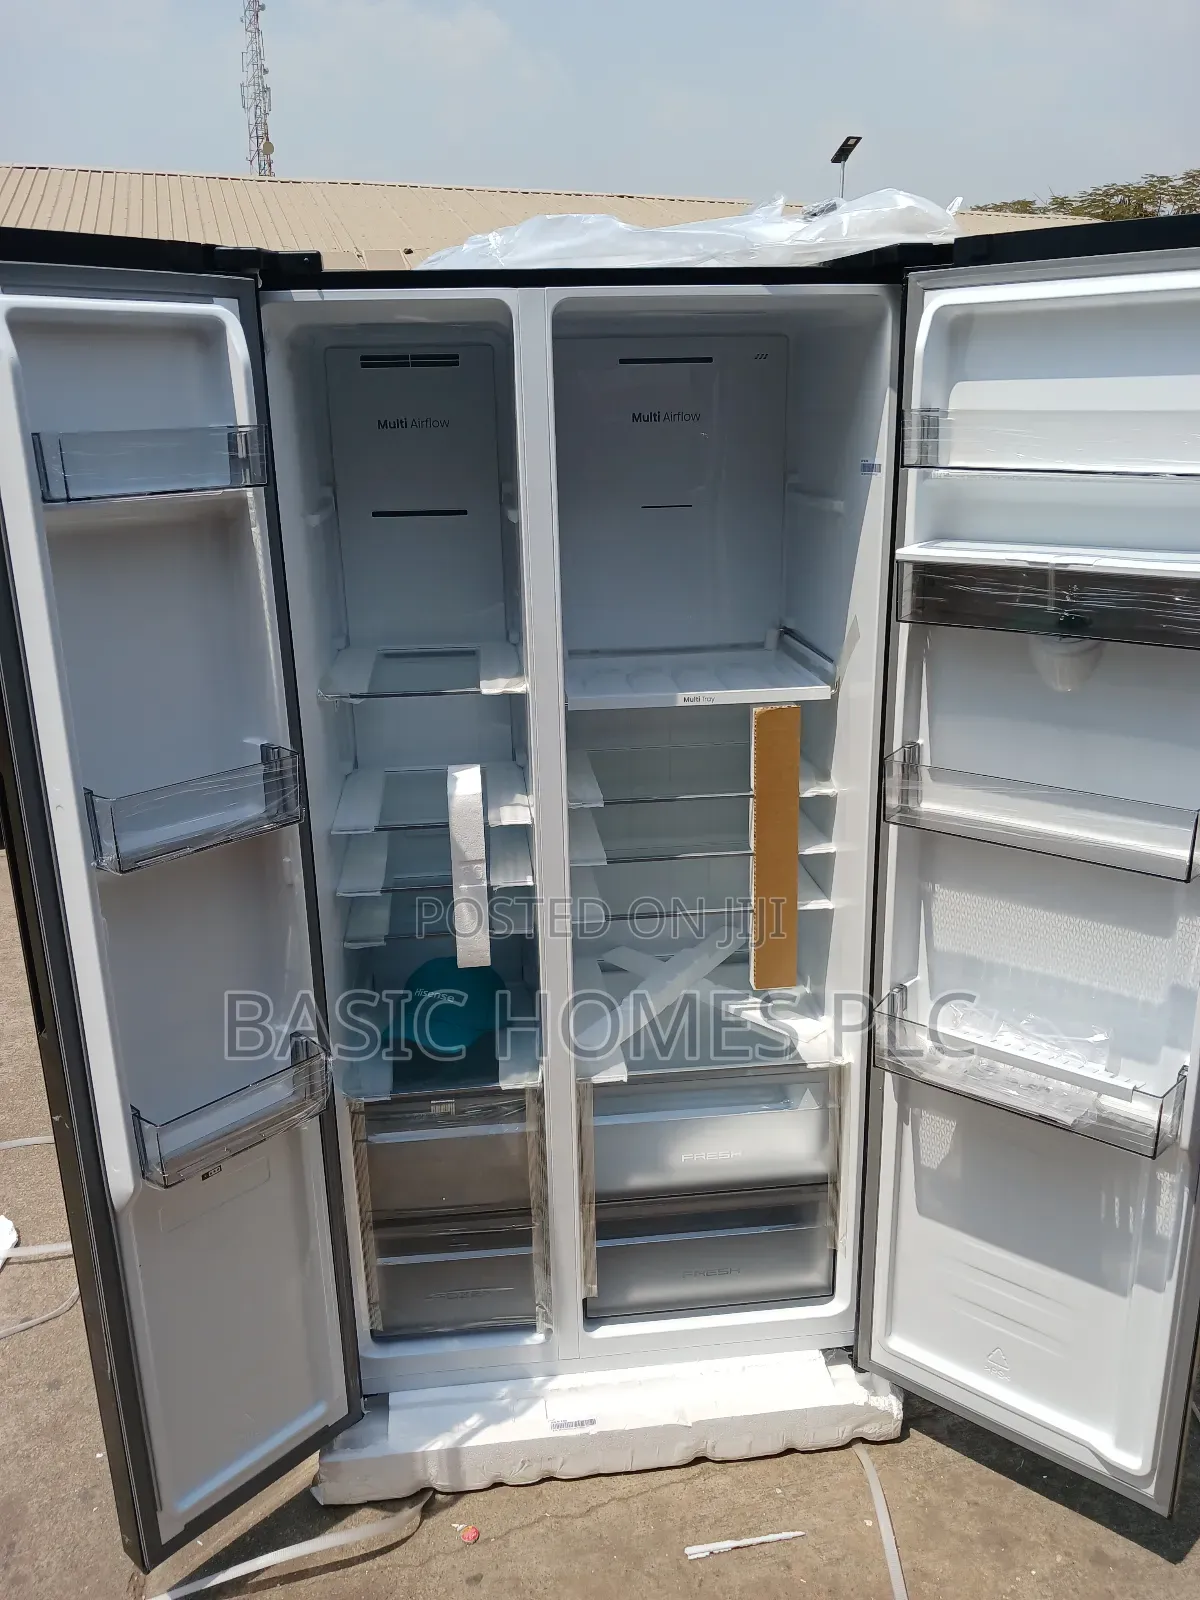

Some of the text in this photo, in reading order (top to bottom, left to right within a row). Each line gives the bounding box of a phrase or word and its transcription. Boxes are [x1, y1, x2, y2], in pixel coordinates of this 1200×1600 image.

[631, 411, 701, 423] Multi Airflow
[377, 417, 450, 430] Multi Airflow
[414, 988, 455, 1003] Hisense
[681, 1150, 742, 1162] FRESH
